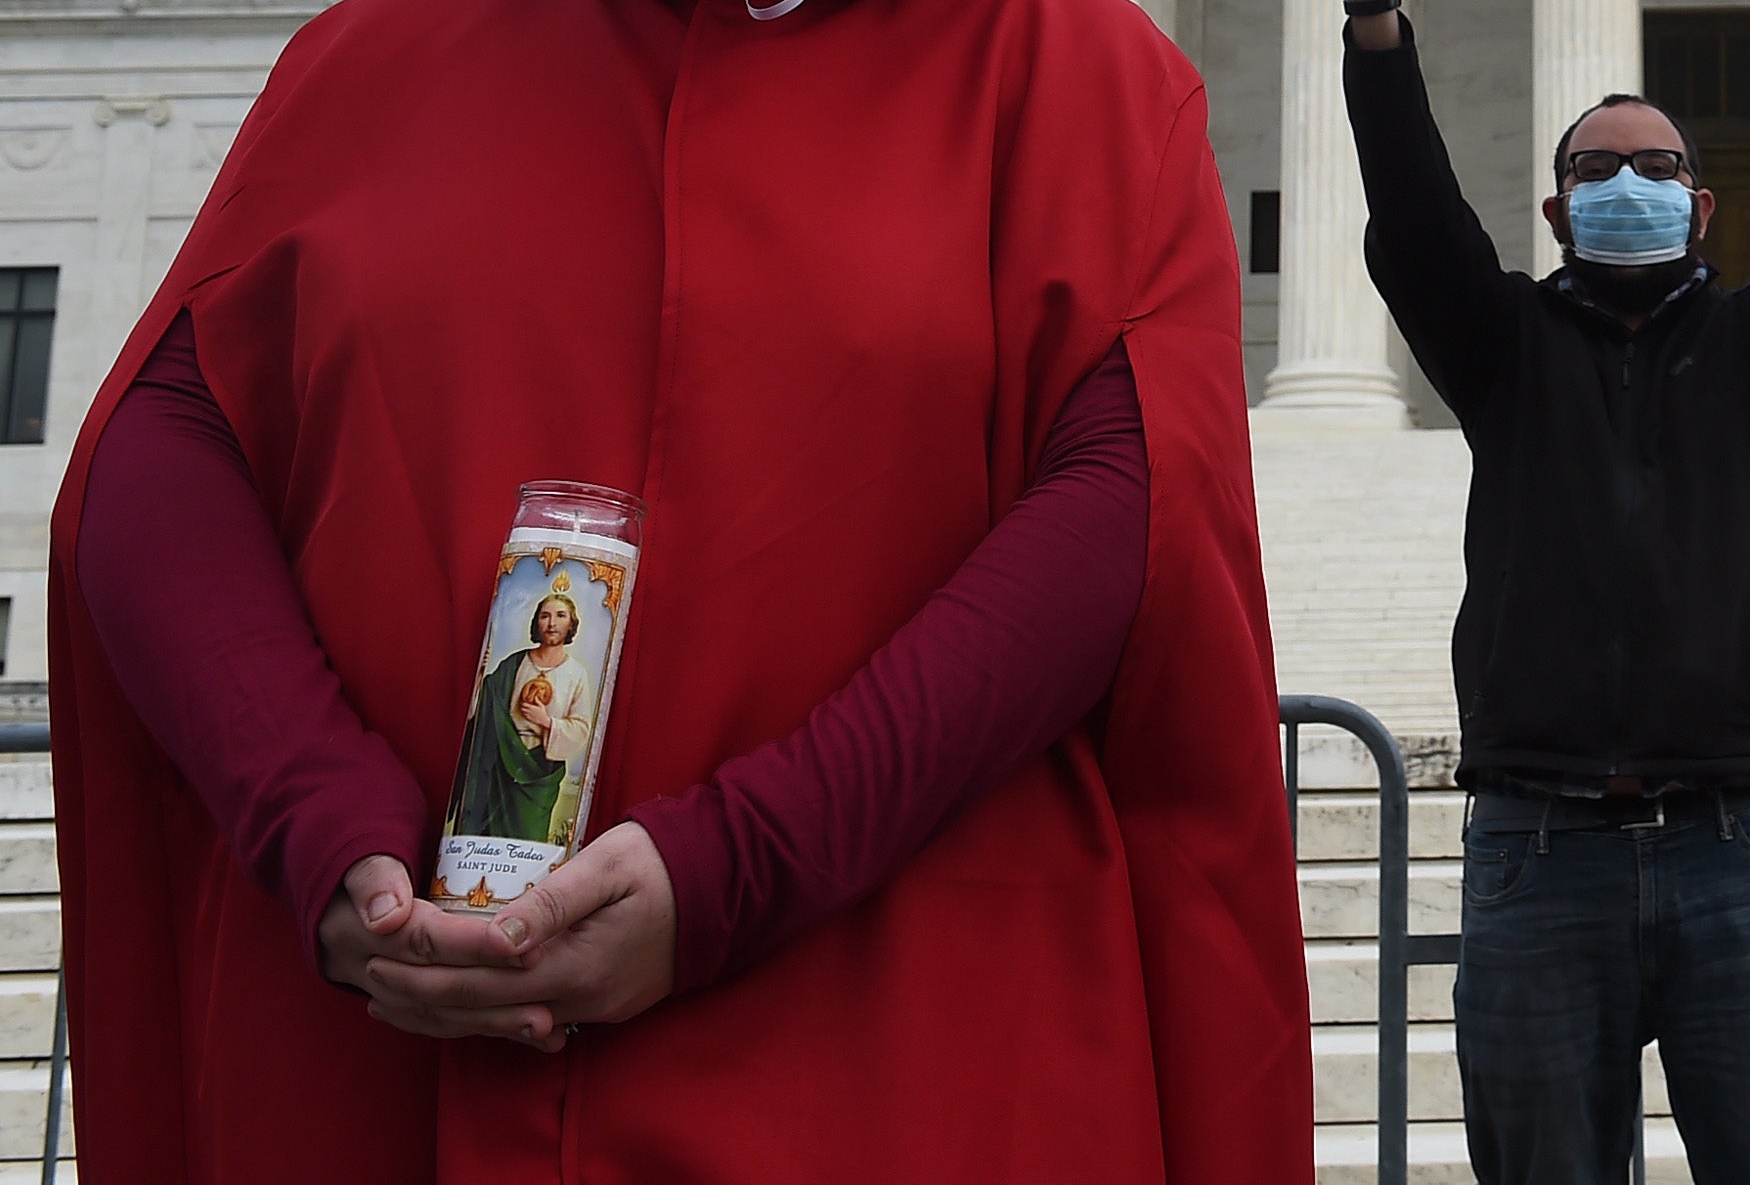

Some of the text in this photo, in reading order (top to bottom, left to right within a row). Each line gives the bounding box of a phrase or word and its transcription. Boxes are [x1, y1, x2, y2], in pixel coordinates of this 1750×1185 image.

[464, 840, 502, 859] Judas
[456, 861, 518, 873] SAINT JUDE
